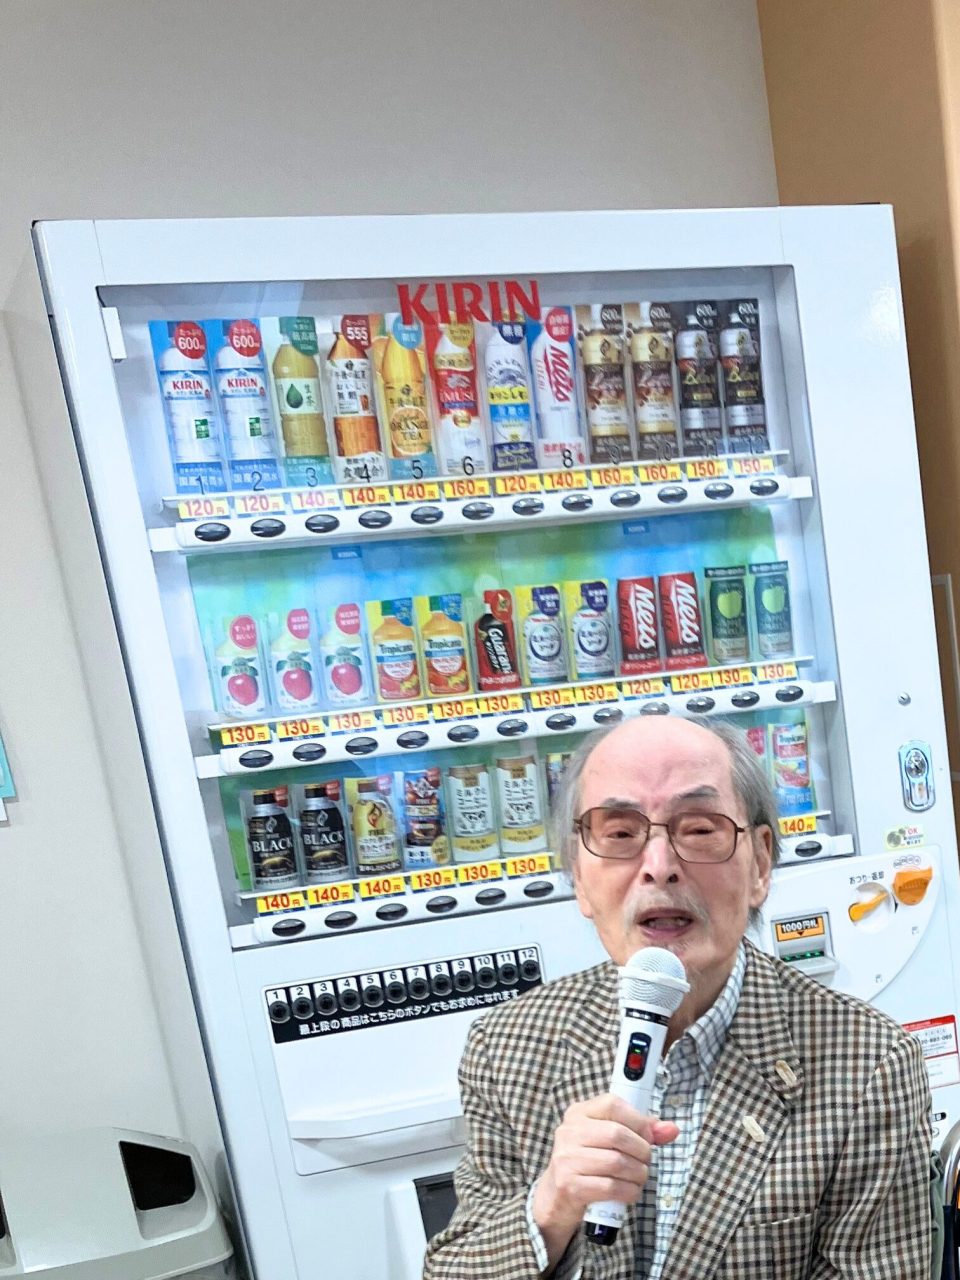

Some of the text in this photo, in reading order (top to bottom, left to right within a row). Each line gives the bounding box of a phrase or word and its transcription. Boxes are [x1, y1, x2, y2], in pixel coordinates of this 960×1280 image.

[397, 280, 541, 326] KIRIN
[346, 326, 368, 340] 555
[172, 379, 204, 391] KIRIN
[227, 377, 258, 389] KIRIN
[550, 344, 575, 402] Mets
[251, 471, 265, 491] 2
[305, 467, 319, 488] 3
[359, 463, 371, 484] 4
[411, 459, 424, 480] 5
[462, 456, 475, 476] 6
[562, 449, 574, 468] 8
[634, 583, 657, 650] Mets
[675, 578, 700, 644] Mets
[252, 836, 293, 852] BLACK
[304, 830, 345, 846] BLACK
[273, 949, 535, 1000] 1 2 3 4 5 6 7 8 9 10 11 12
